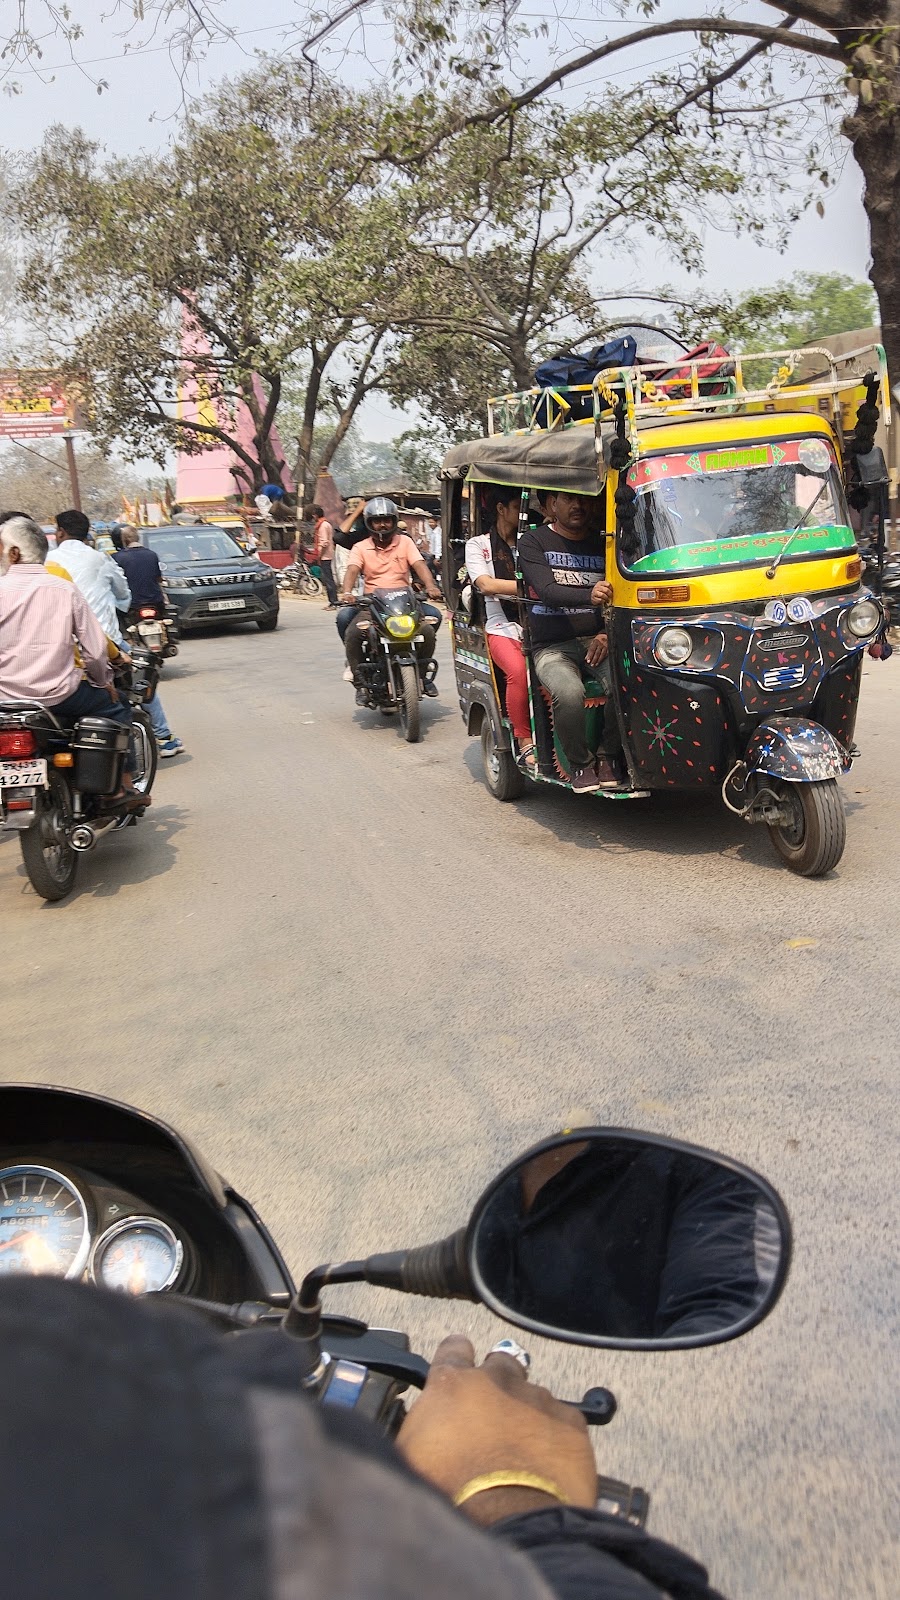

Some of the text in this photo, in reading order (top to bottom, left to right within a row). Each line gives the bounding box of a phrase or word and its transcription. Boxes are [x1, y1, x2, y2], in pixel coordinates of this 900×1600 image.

[706, 446, 768, 471] ARMAN
[688, 544, 717, 555] एक
[721, 541, 748, 550] बार
[0, 773, 42, 785] 4277
[3, 1199, 14, 1207] 60
[19, 1195, 43, 1203] 70 80
